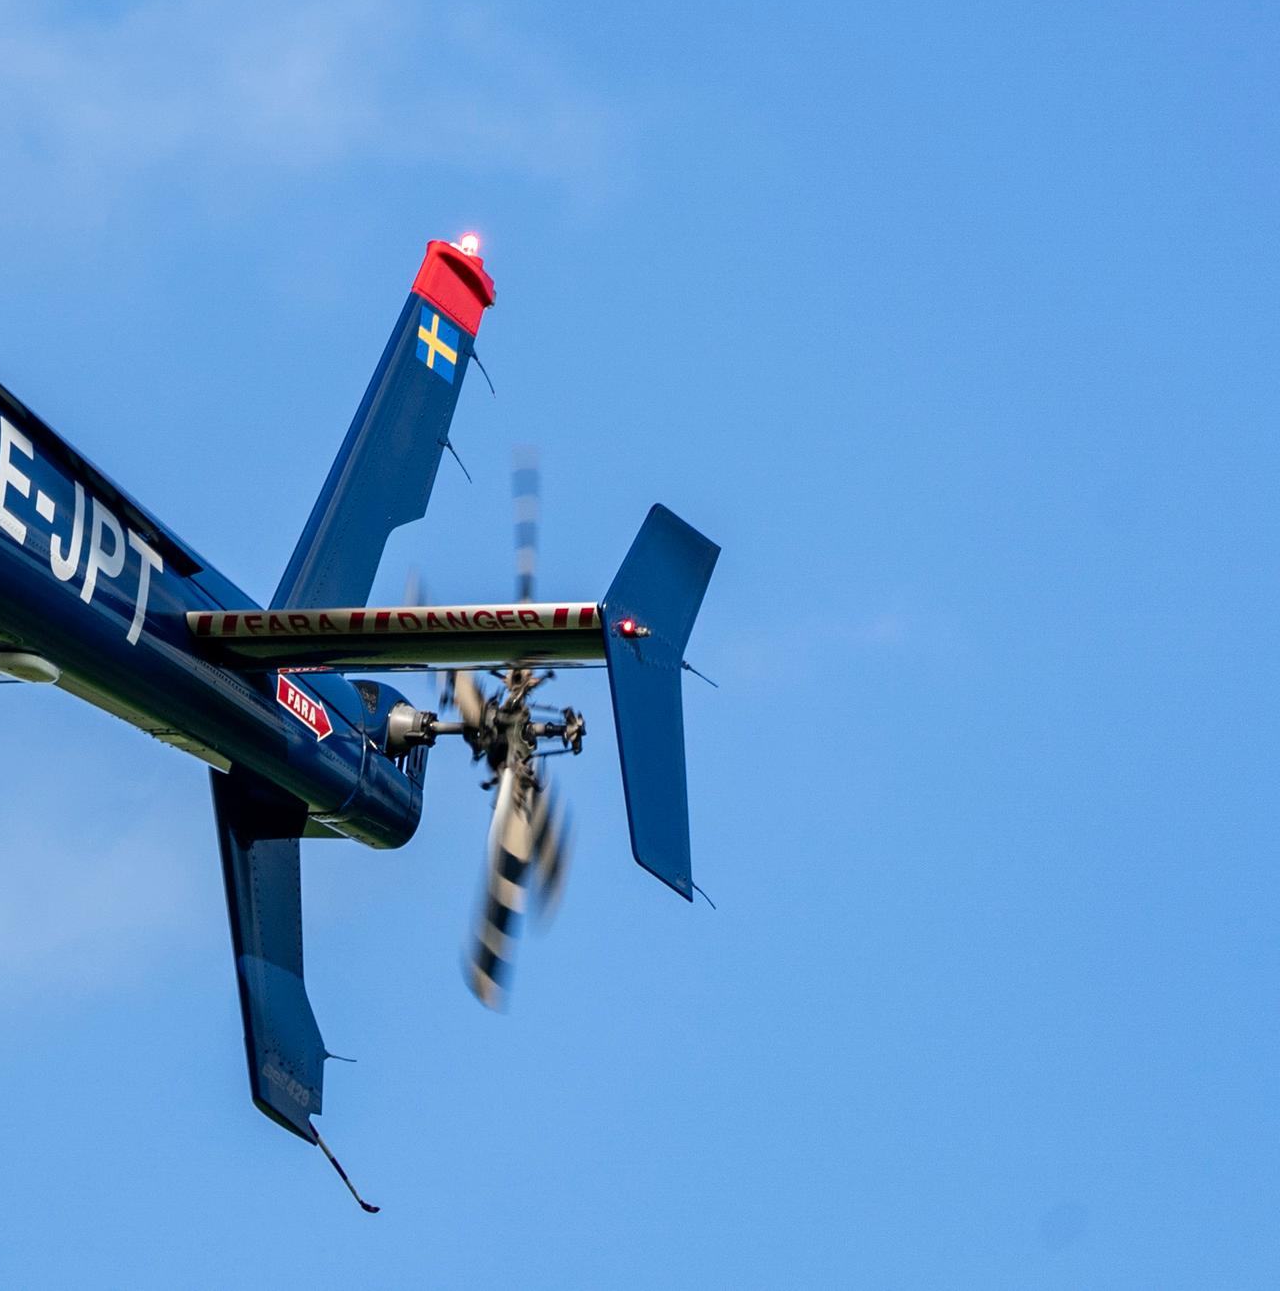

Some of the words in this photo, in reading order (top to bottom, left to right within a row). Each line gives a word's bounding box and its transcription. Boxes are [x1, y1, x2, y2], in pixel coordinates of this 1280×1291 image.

[244, 614, 337, 634] FARA
[396, 609, 545, 631] DANGER
[287, 687, 316, 726] FARA
